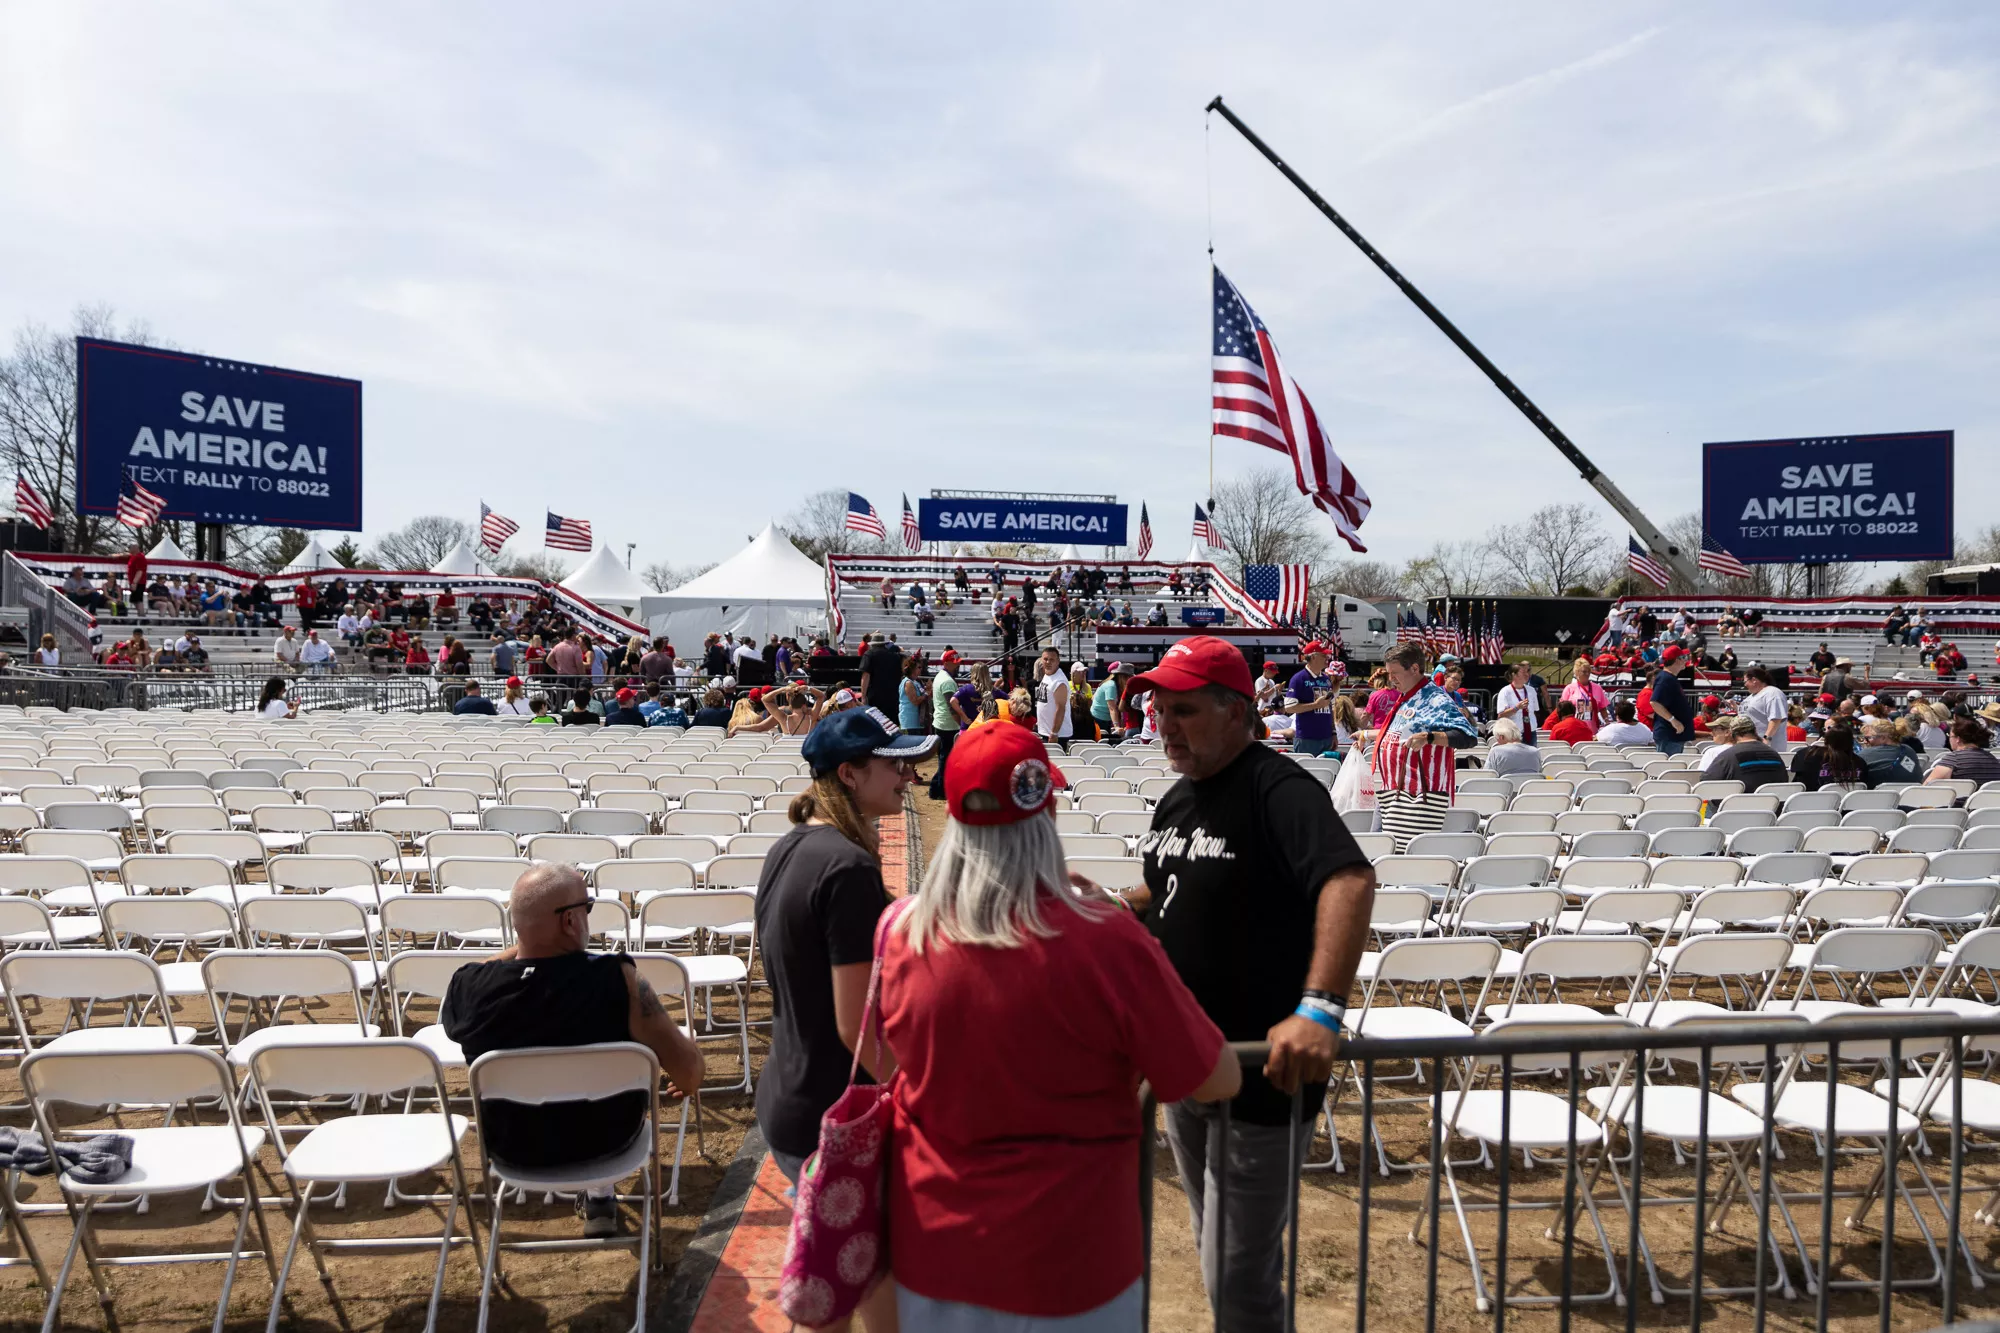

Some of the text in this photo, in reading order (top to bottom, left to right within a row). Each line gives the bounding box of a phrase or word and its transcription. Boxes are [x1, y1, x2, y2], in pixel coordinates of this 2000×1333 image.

[180, 390, 285, 432] SAVE
[129, 426, 327, 475] AMERICA!
[127, 464, 330, 497] TEXT RALLY TO 88022
[1780, 462, 1874, 489] SAVE
[939, 511, 1109, 533] SAVE AMERICA!
[1740, 492, 1916, 521] AMERICA!
[1739, 521, 1918, 538] TEXT RALLY TO 88022
[1156, 826, 1187, 869] You
